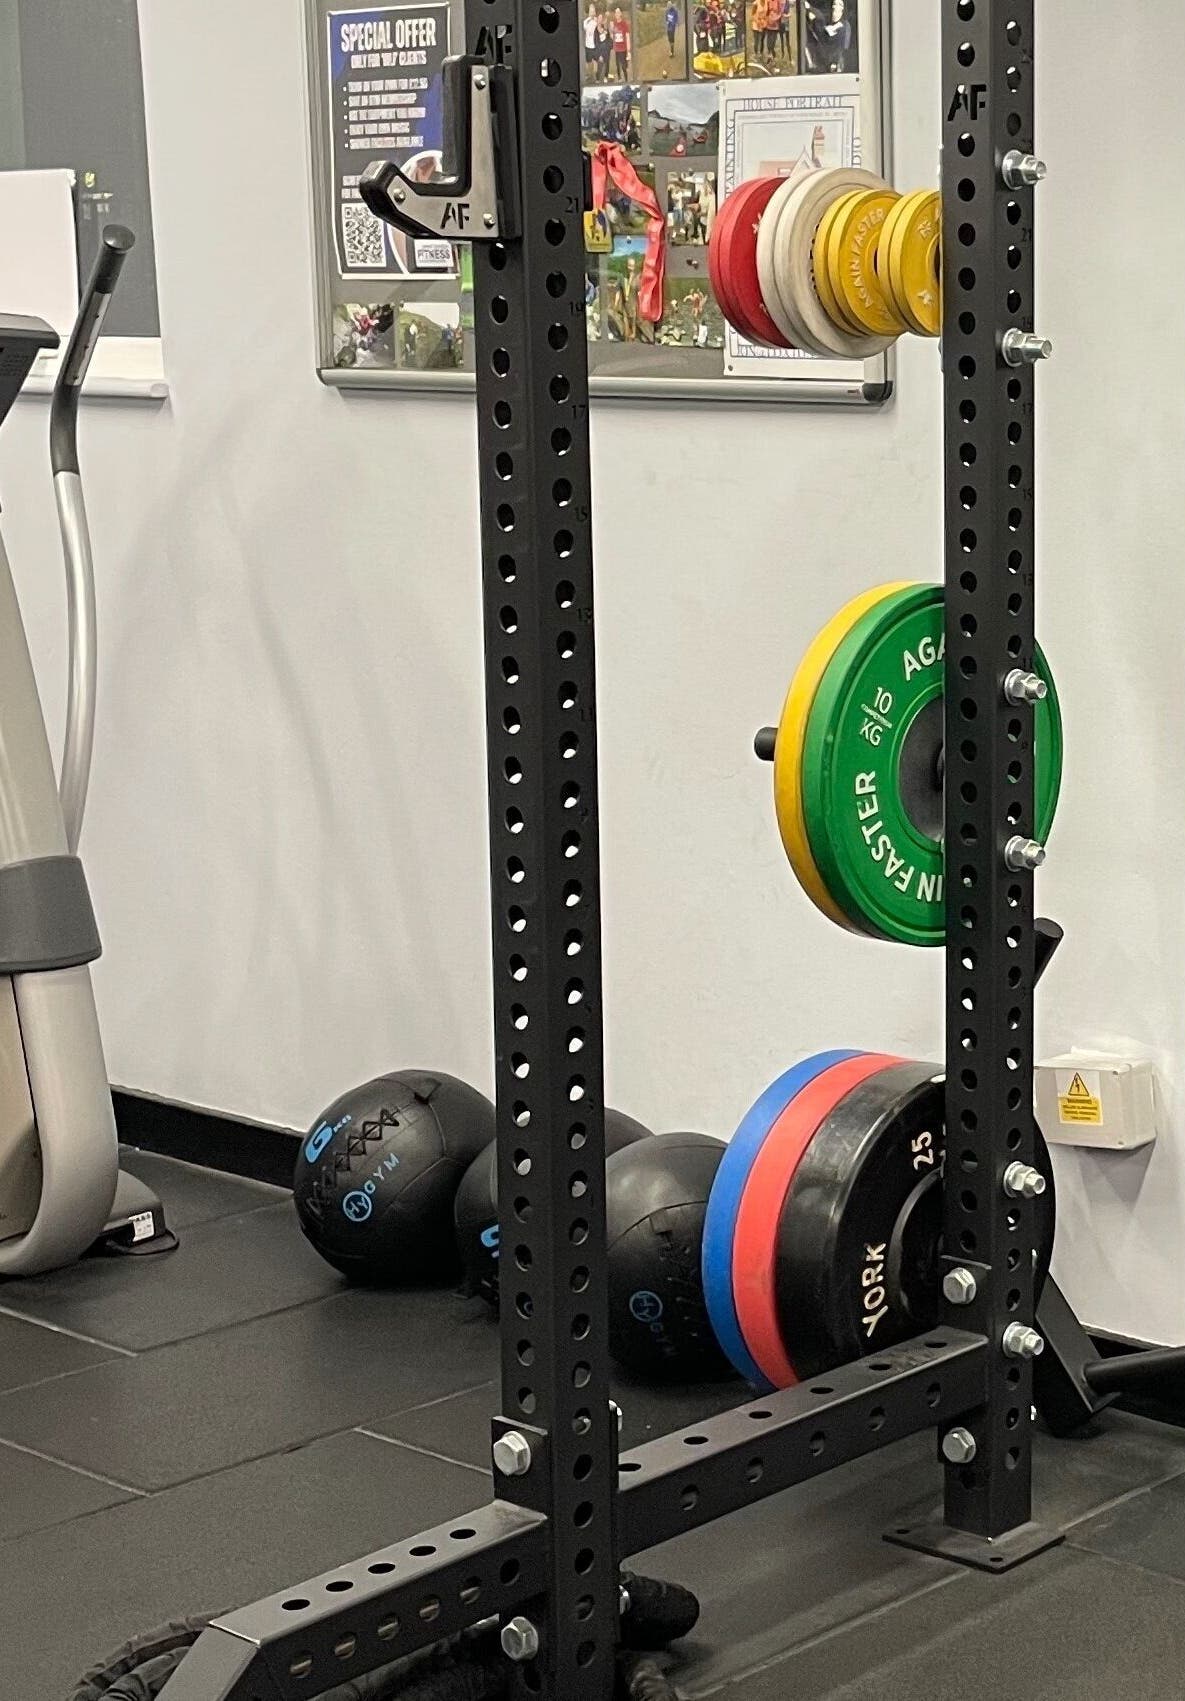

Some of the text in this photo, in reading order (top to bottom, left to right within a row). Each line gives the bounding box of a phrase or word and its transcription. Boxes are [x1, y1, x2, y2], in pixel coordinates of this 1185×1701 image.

[341, 17, 437, 53] SPECIAL OFFER
[947, 84, 987, 122] AF
[440, 202, 470, 230] AF
[874, 687, 892, 714] 10
[860, 718, 883, 746] KG
[855, 770, 915, 894] FASTER
[911, 1131, 934, 1170] 25
[364, 1152, 400, 1194] GYM
[861, 1242, 889, 1338] YORK
